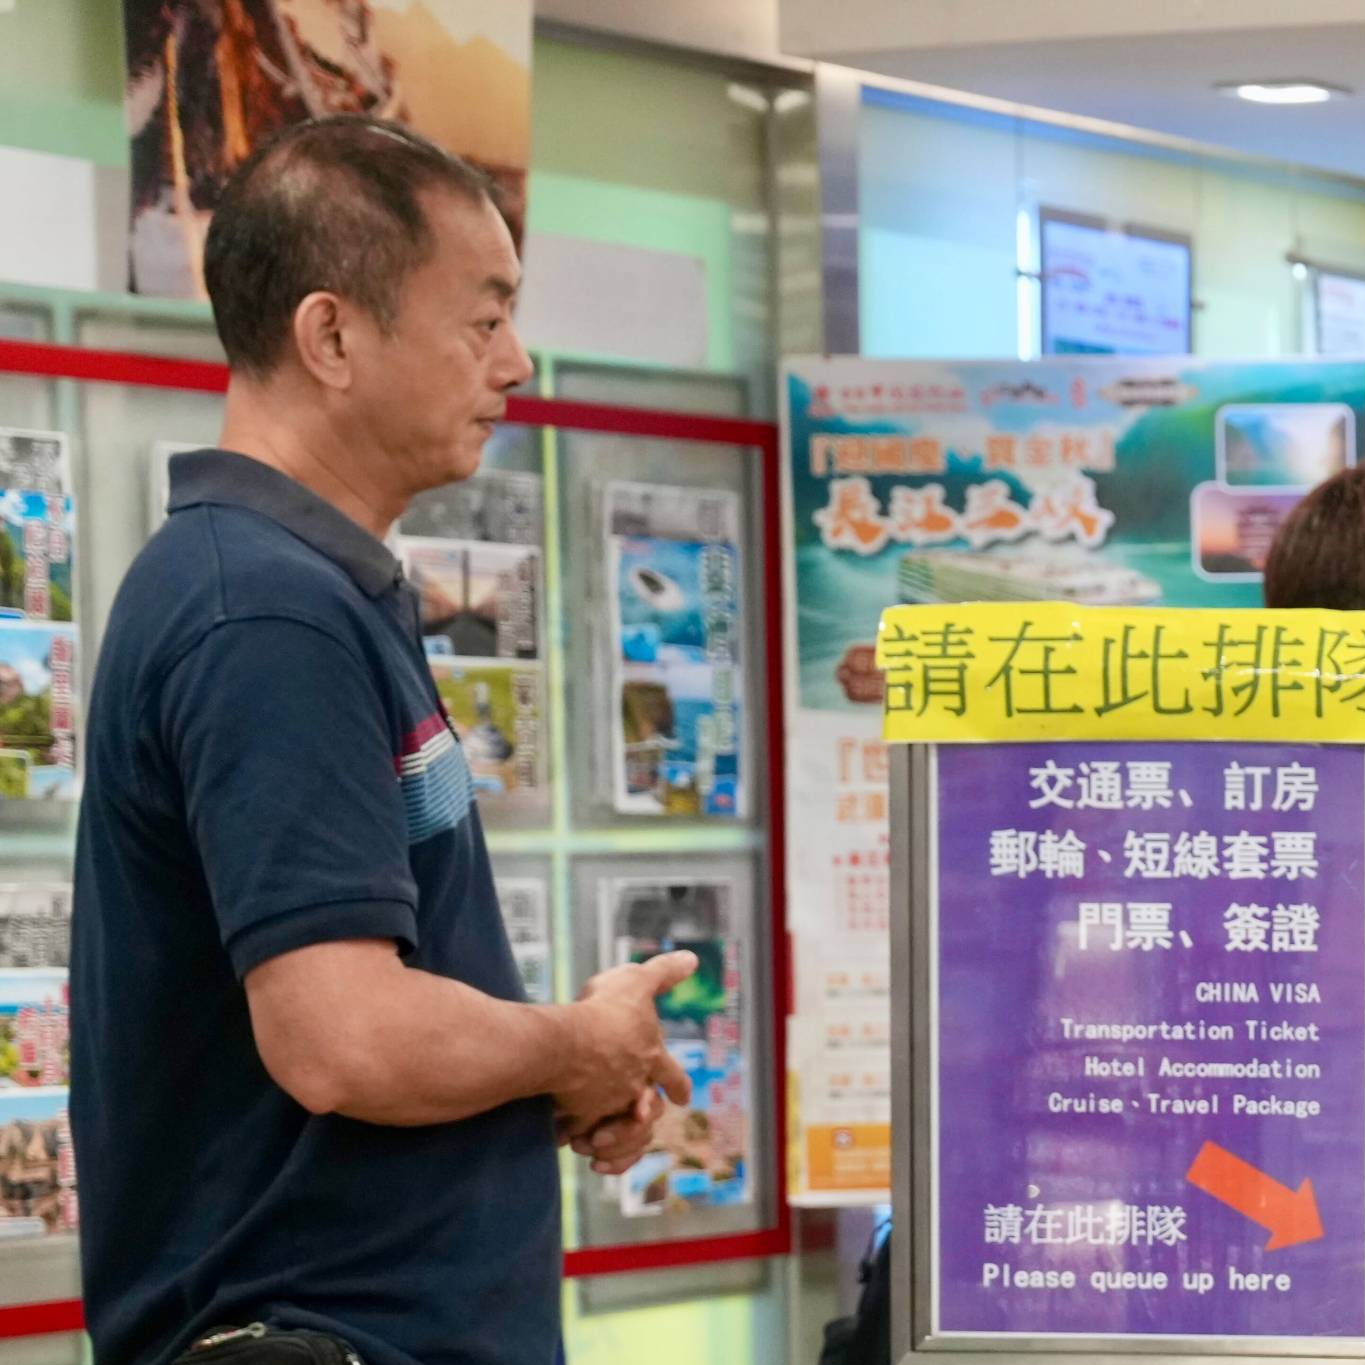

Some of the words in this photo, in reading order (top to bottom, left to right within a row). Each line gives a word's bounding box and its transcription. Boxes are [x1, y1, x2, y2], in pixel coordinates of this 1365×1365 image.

[1029, 760, 1318, 811] 交通票、訂房
[989, 829, 1318, 880] 郵輪、短線套票
[1078, 903, 1319, 954] 門票、簽證
[1196, 982, 1259, 1004] CHINA
[1271, 982, 1321, 1004] VISA
[1061, 1019, 1233, 1042] Transportation
[1246, 1020, 1320, 1042] Ticket
[1085, 1056, 1145, 1077] Hotel
[1159, 1056, 1320, 1078] Accommodation
[1233, 1093, 1320, 1117] Package
[983, 1203, 1187, 1246] 請在此排隊
[983, 1262, 1076, 1289] Please
[1091, 1267, 1168, 1292] queue
[1183, 1269, 1214, 1294] up
[1229, 1265, 1291, 1292] here
